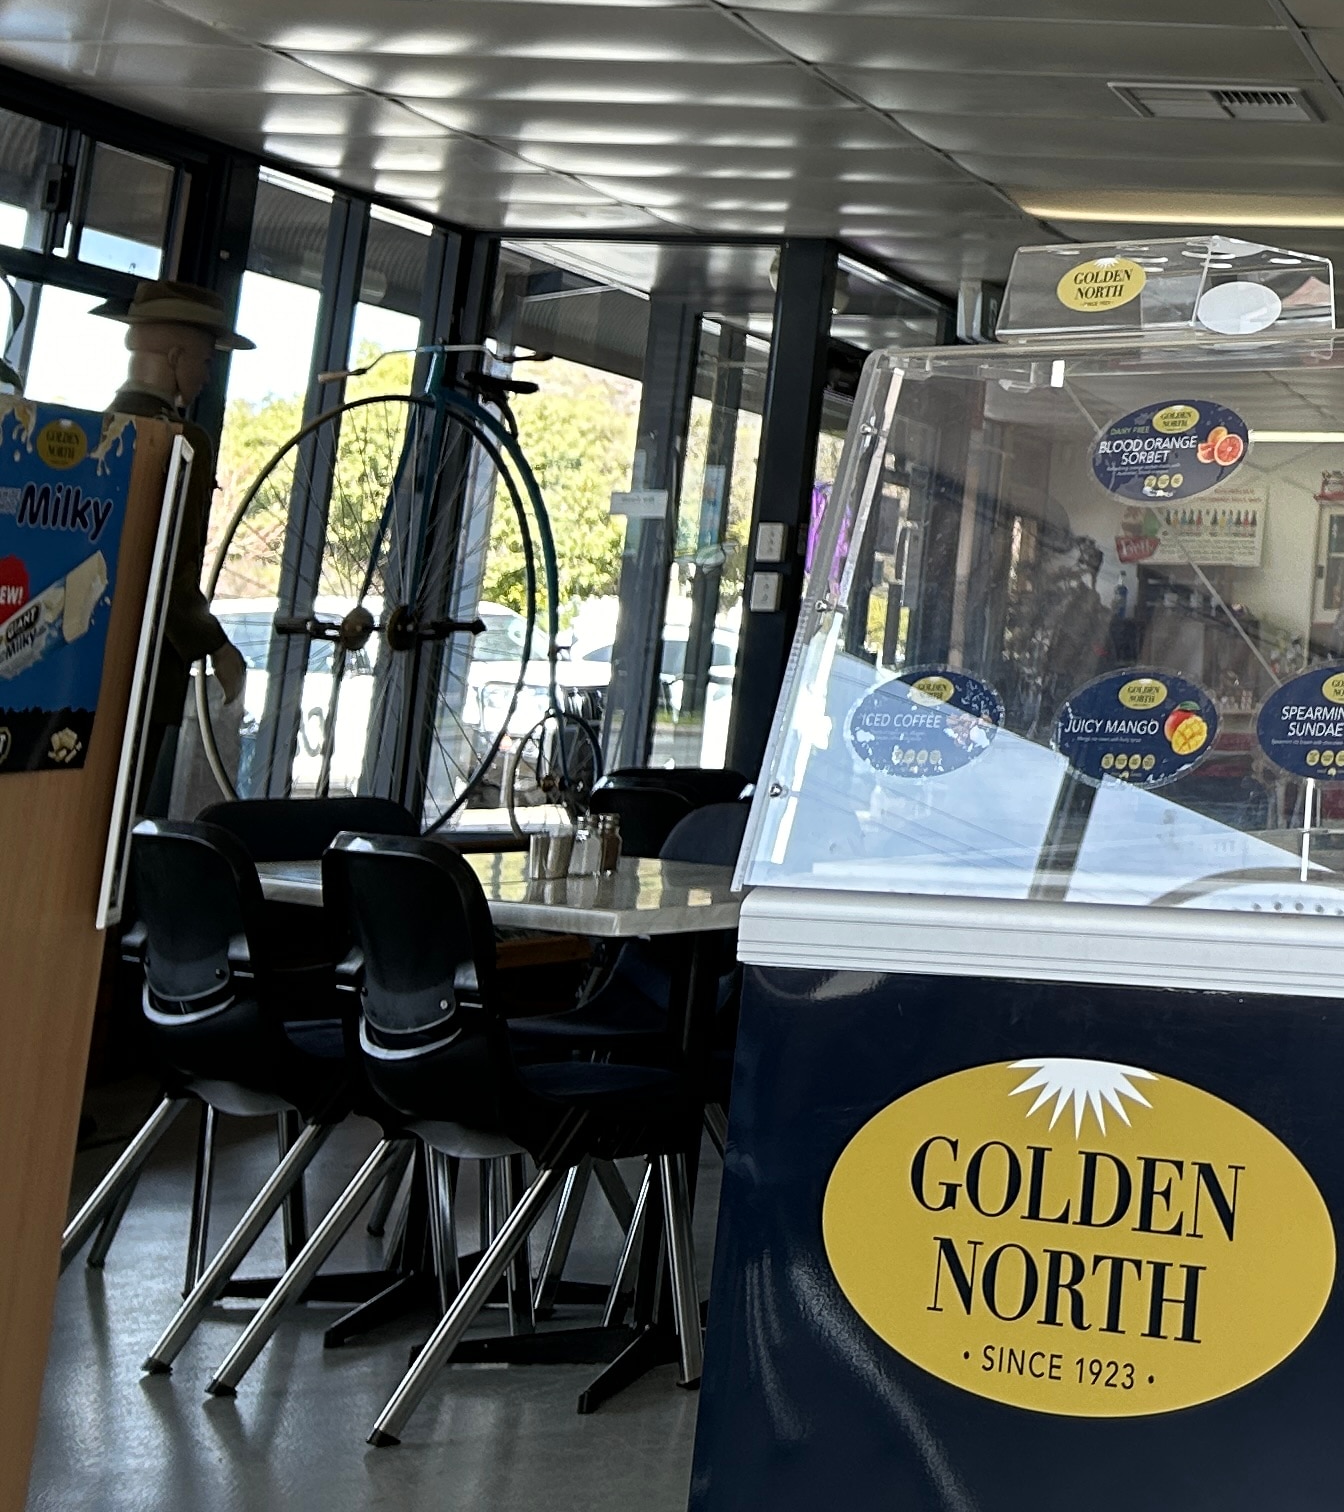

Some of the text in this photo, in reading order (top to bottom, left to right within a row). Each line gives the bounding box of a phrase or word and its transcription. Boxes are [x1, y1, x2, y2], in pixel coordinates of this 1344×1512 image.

[1073, 269, 1134, 285] GOLDEN
[1075, 284, 1124, 300] NORTH
[1098, 436, 1198, 454] BLOOD ORANGE
[1121, 450, 1170, 465] SORBET
[17, 482, 113, 543] Milky
[861, 712, 942, 728] ICED COFFEE
[1064, 718, 1160, 735] JUICY MANGO
[1287, 722, 1344, 737] SUNDAE
[910, 1135, 1246, 1242] GOLDEN
[926, 1236, 1207, 1344] NORTH
[981, 1344, 1136, 1390] SINCE 1923
